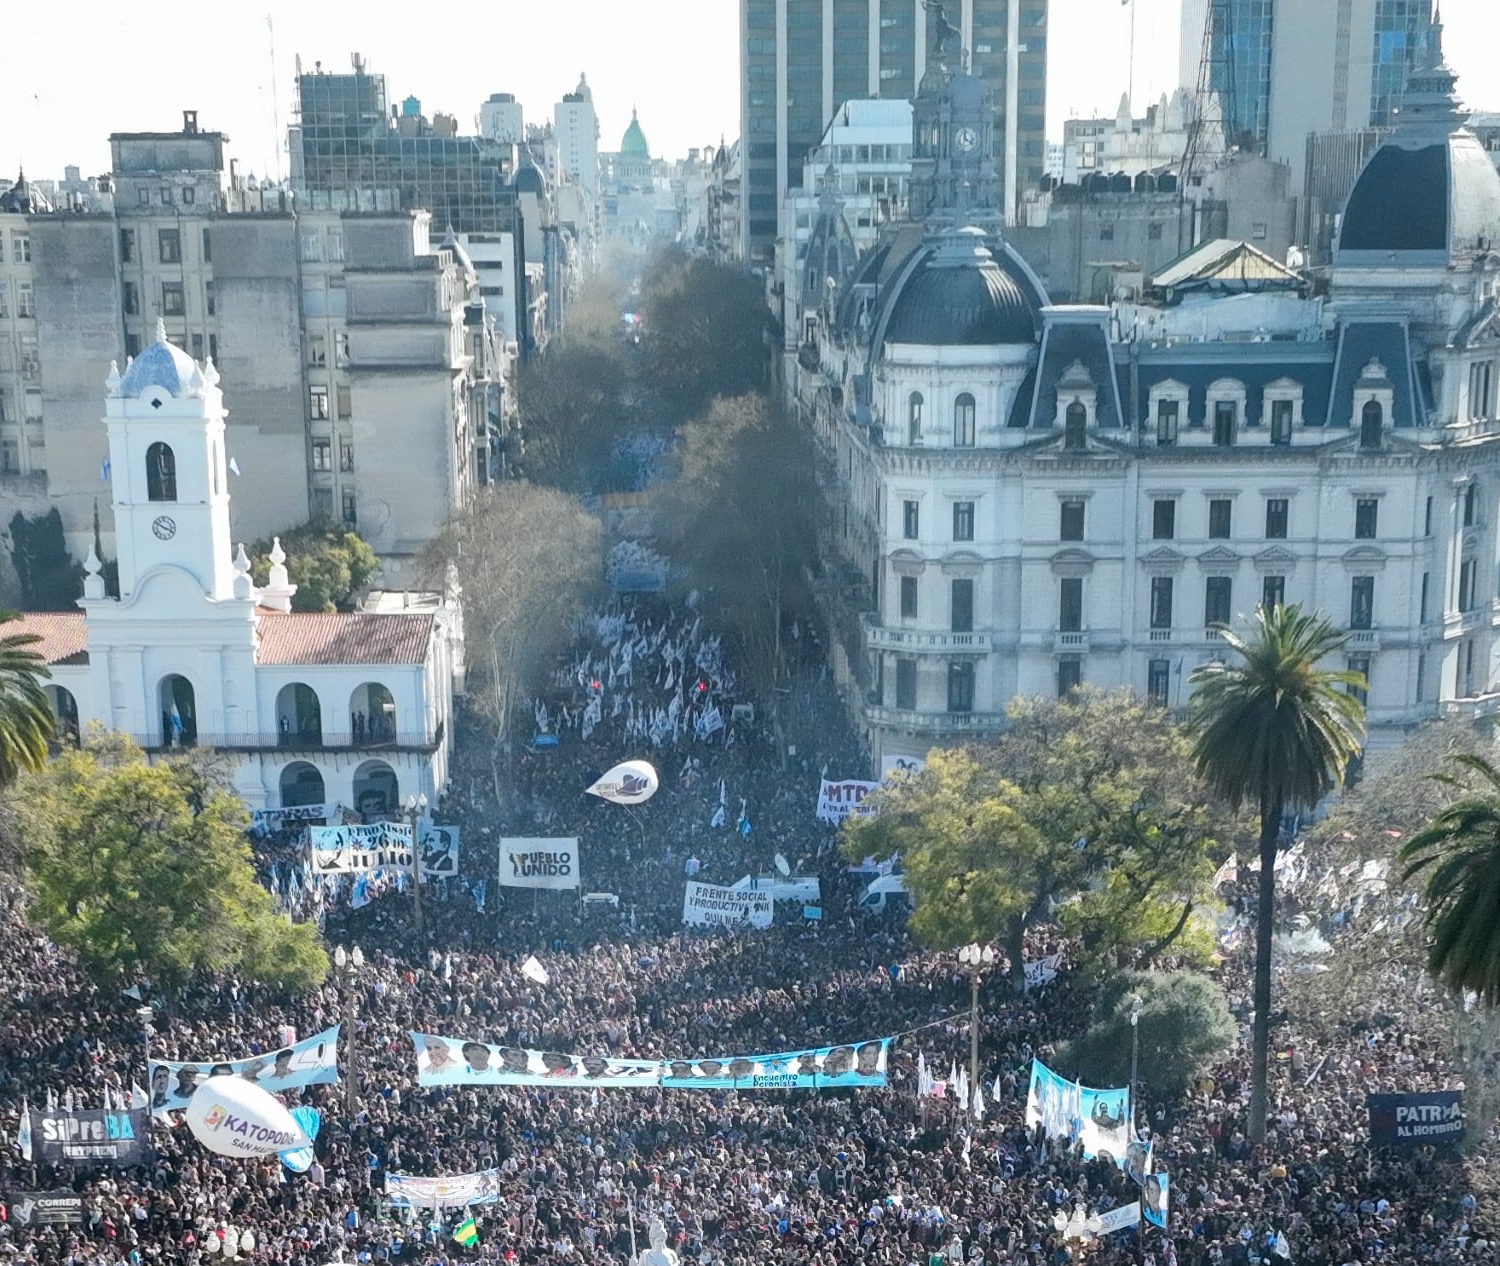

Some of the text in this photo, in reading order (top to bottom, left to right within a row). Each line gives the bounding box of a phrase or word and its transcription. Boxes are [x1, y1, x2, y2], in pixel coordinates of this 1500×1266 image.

[349, 851, 413, 867] JULIO
[522, 851, 571, 864] PUEBLO
[522, 864, 571, 876] UNIDO
[696, 886, 768, 902] FRENTE SOCIAL
[43, 1114, 135, 1141] SiPreBA
[223, 1114, 297, 1146] KATOPODIS
[1397, 1120, 1462, 1136] AL HOMBRO
[232, 1138, 256, 1151] SAN
[38, 1199, 82, 1208] CORREPI
